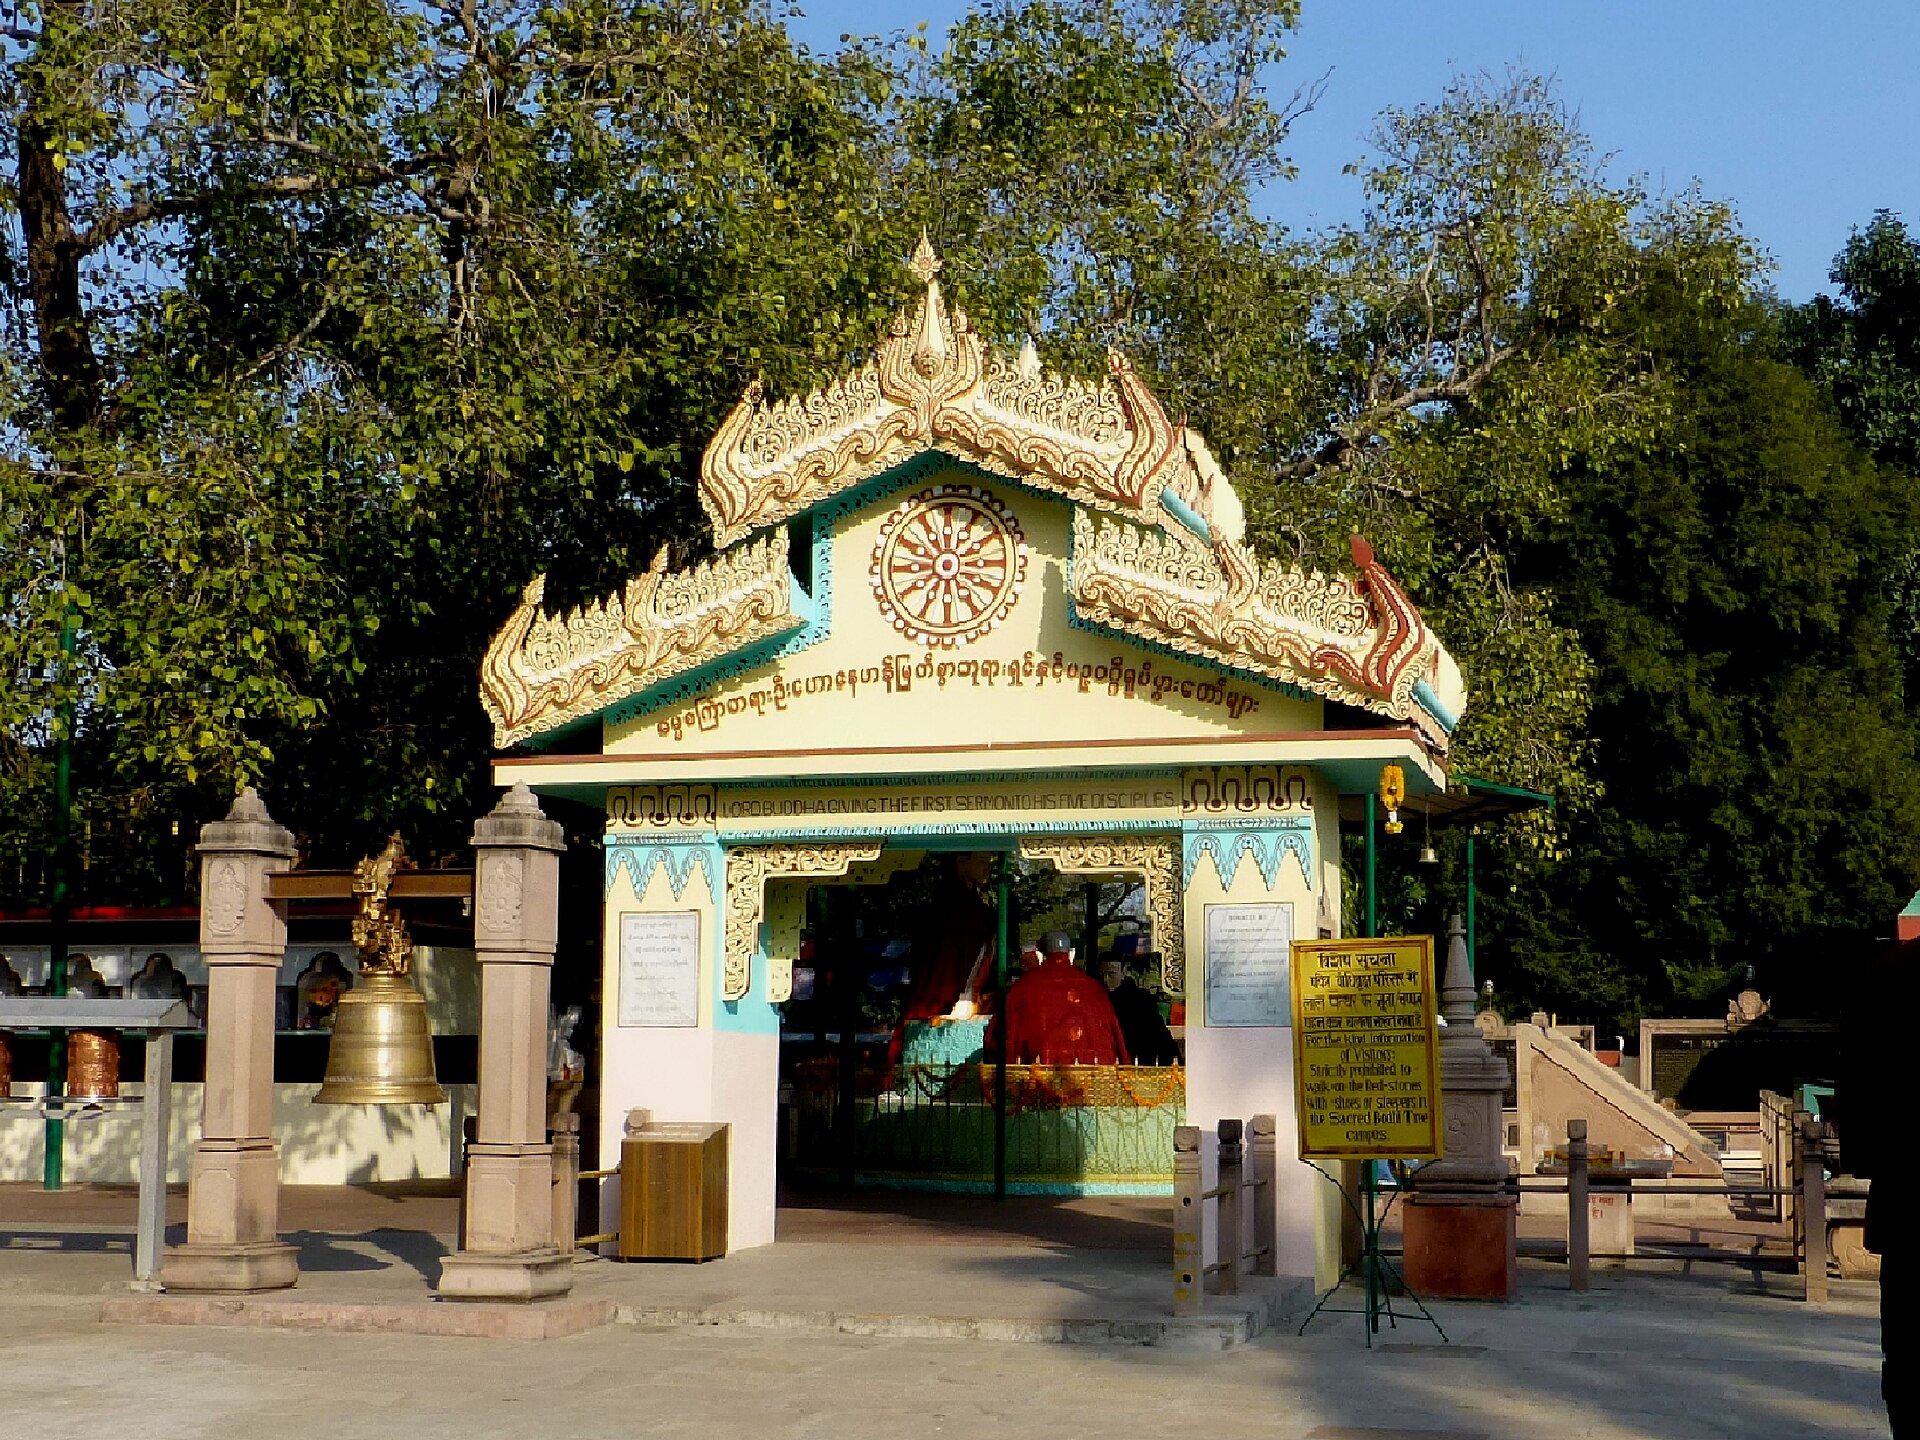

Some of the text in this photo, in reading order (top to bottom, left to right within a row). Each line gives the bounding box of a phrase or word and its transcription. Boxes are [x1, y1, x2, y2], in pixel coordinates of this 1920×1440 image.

[722, 792, 1173, 818] LORD BUDDHA GIVING THE FIRST SERMON TO HIS FIVE DISCIPLES
[1329, 1111, 1371, 1124] Sacred
